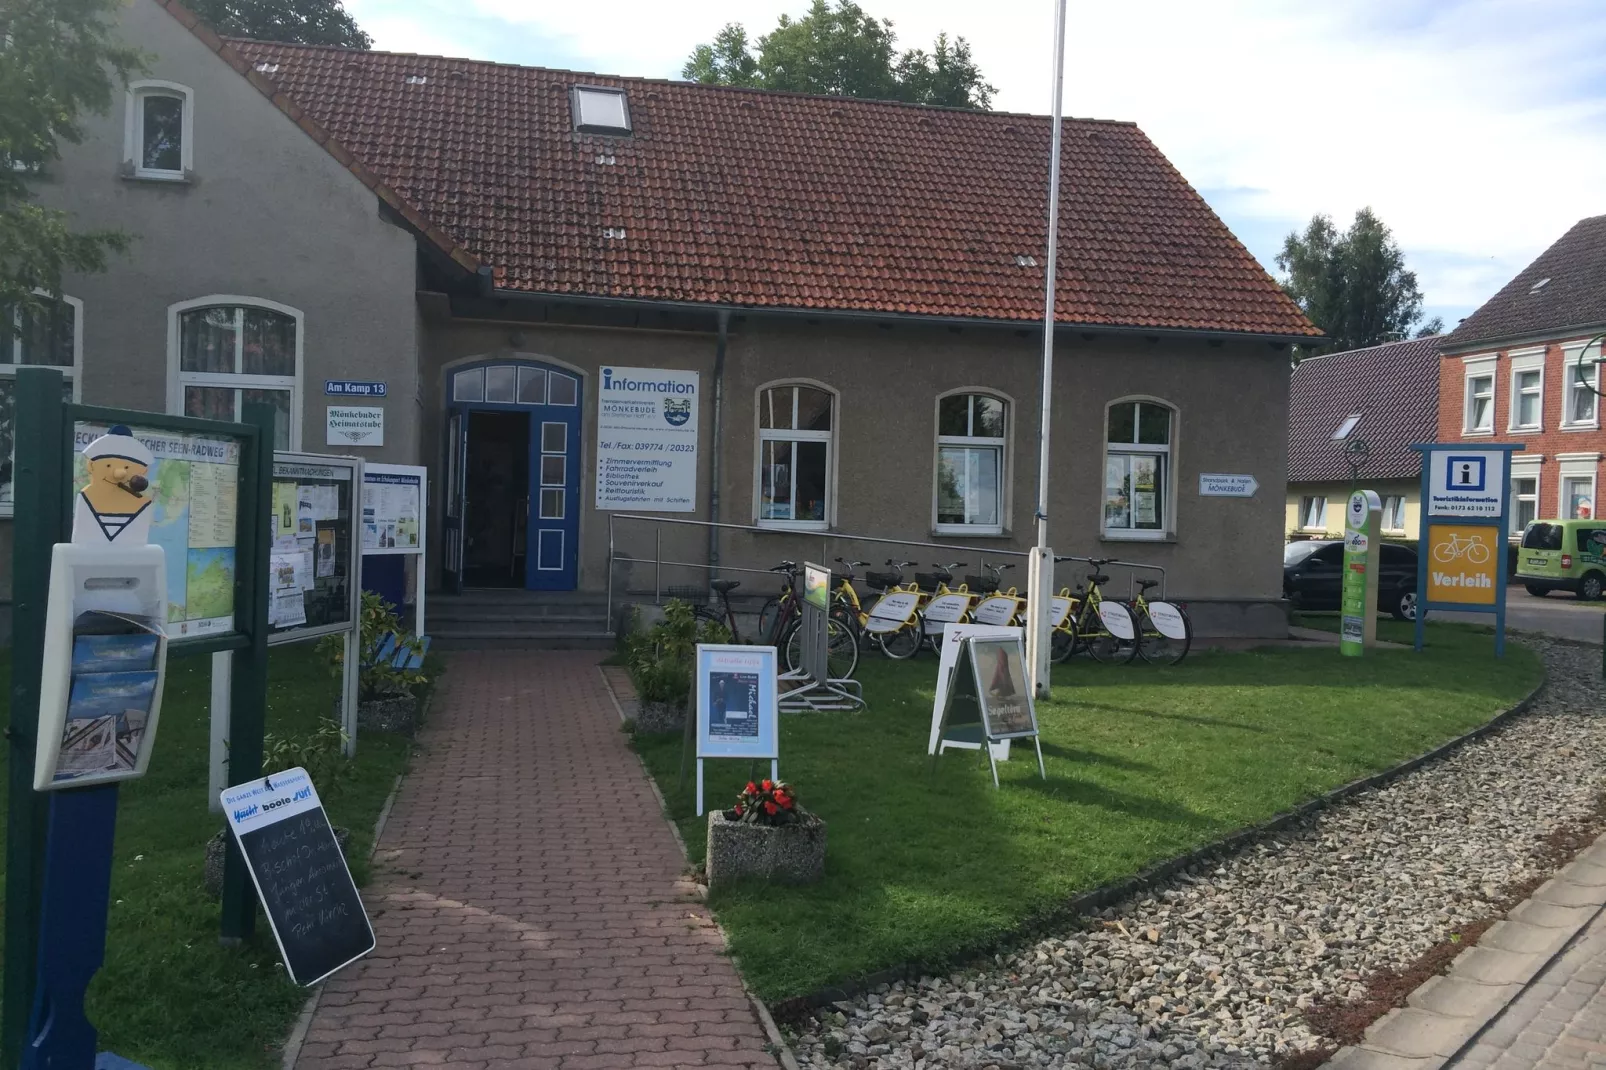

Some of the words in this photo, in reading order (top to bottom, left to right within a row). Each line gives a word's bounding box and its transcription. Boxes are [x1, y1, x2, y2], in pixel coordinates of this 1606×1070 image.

[328, 382, 342, 391] Am
[345, 383, 370, 395] Kamp
[373, 384, 384, 393] 13
[169, 441, 224, 458] SEEN-RADWEG
[606, 458, 673, 468] Zimmervermittlung
[605, 472, 640, 480] Bibliothek
[605, 479, 664, 488] Souvenirverkauf
[605, 487, 645, 495] Reittouristik
[1433, 495, 1499, 503] Touristikinformation
[1432, 571, 1492, 588] Verleih
[262, 797, 292, 812] boote
